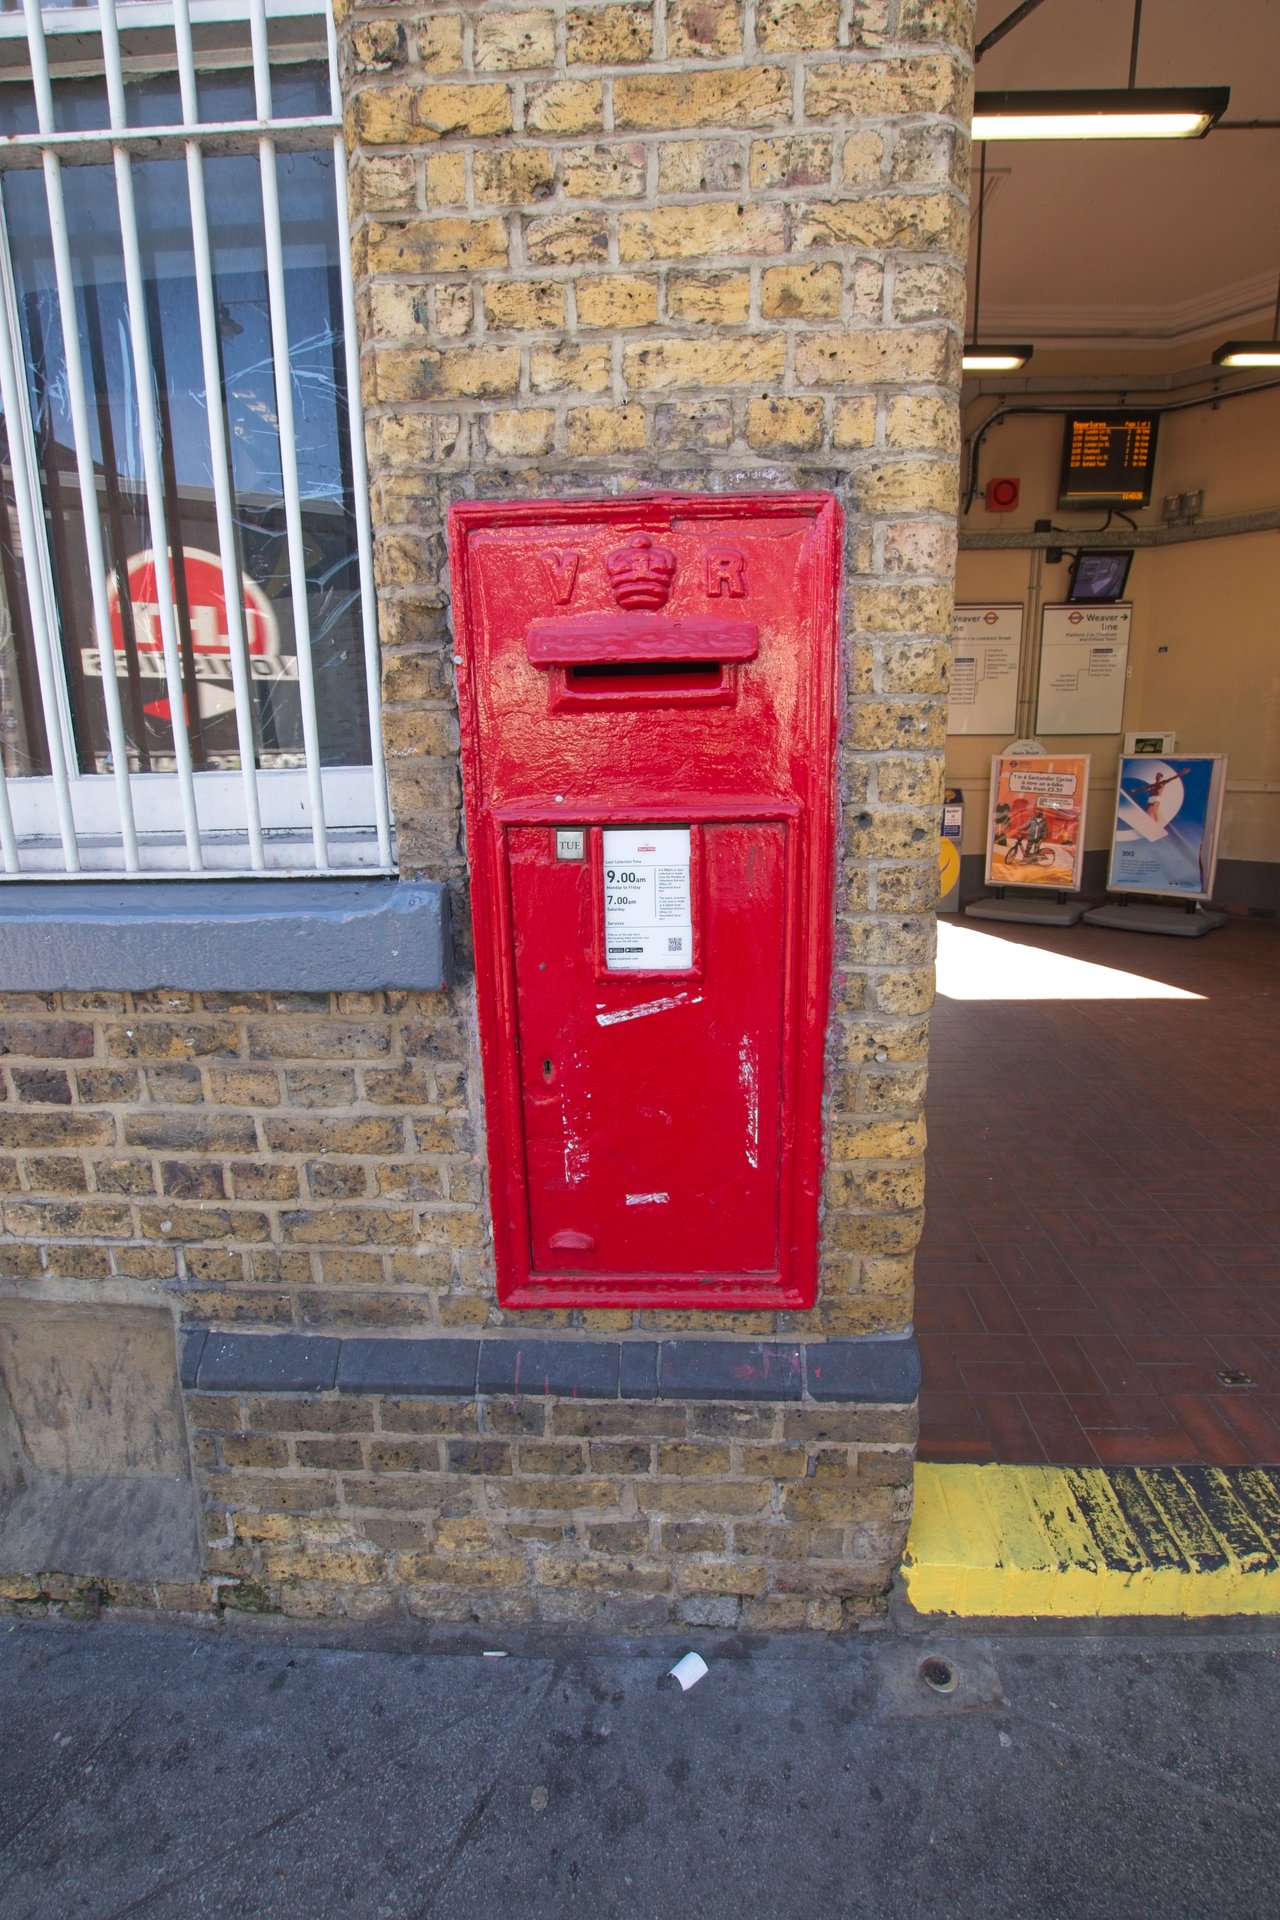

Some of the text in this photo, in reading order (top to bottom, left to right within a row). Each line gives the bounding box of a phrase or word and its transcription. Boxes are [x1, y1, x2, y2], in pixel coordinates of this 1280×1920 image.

[540, 551, 579, 605] V
[706, 546, 746, 598] R
[559, 841, 581, 850] TUE
[607, 870, 646, 883] 9.00am
[607, 895, 636, 905] 7.00am
